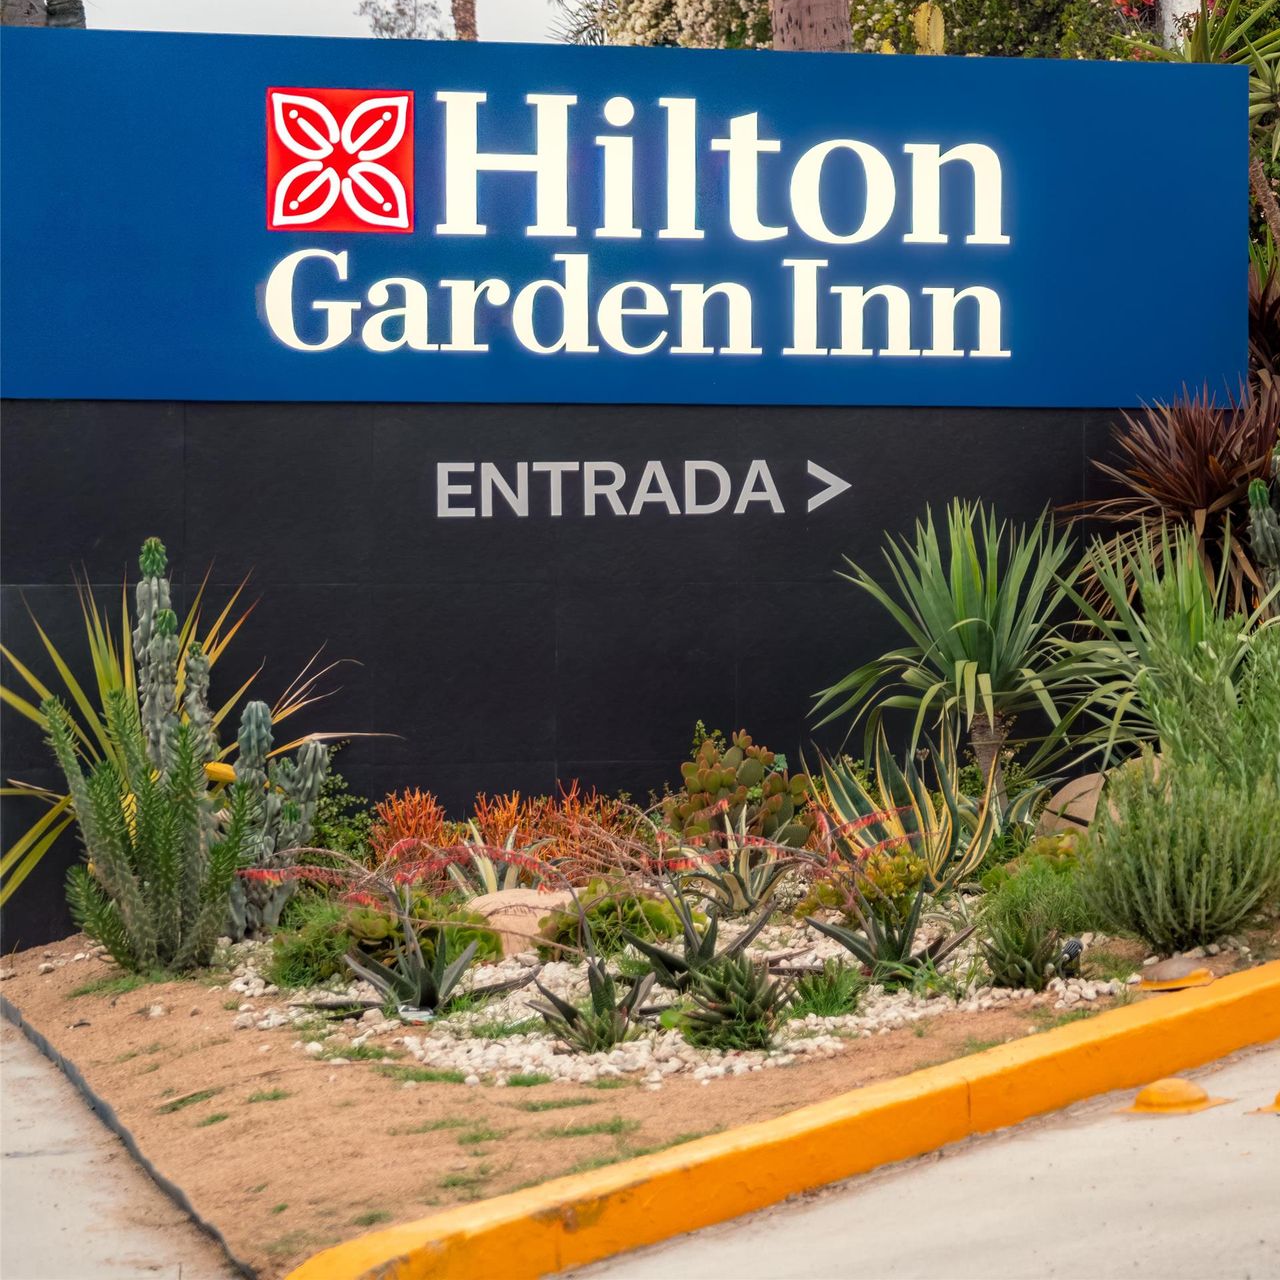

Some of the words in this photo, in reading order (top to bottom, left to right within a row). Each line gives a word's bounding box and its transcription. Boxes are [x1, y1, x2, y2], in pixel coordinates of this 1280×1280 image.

[435, 91, 1011, 245] Hilton
[264, 248, 763, 355] Garden
[782, 258, 1012, 358] Inn
[436, 459, 786, 518] ENTRADA
